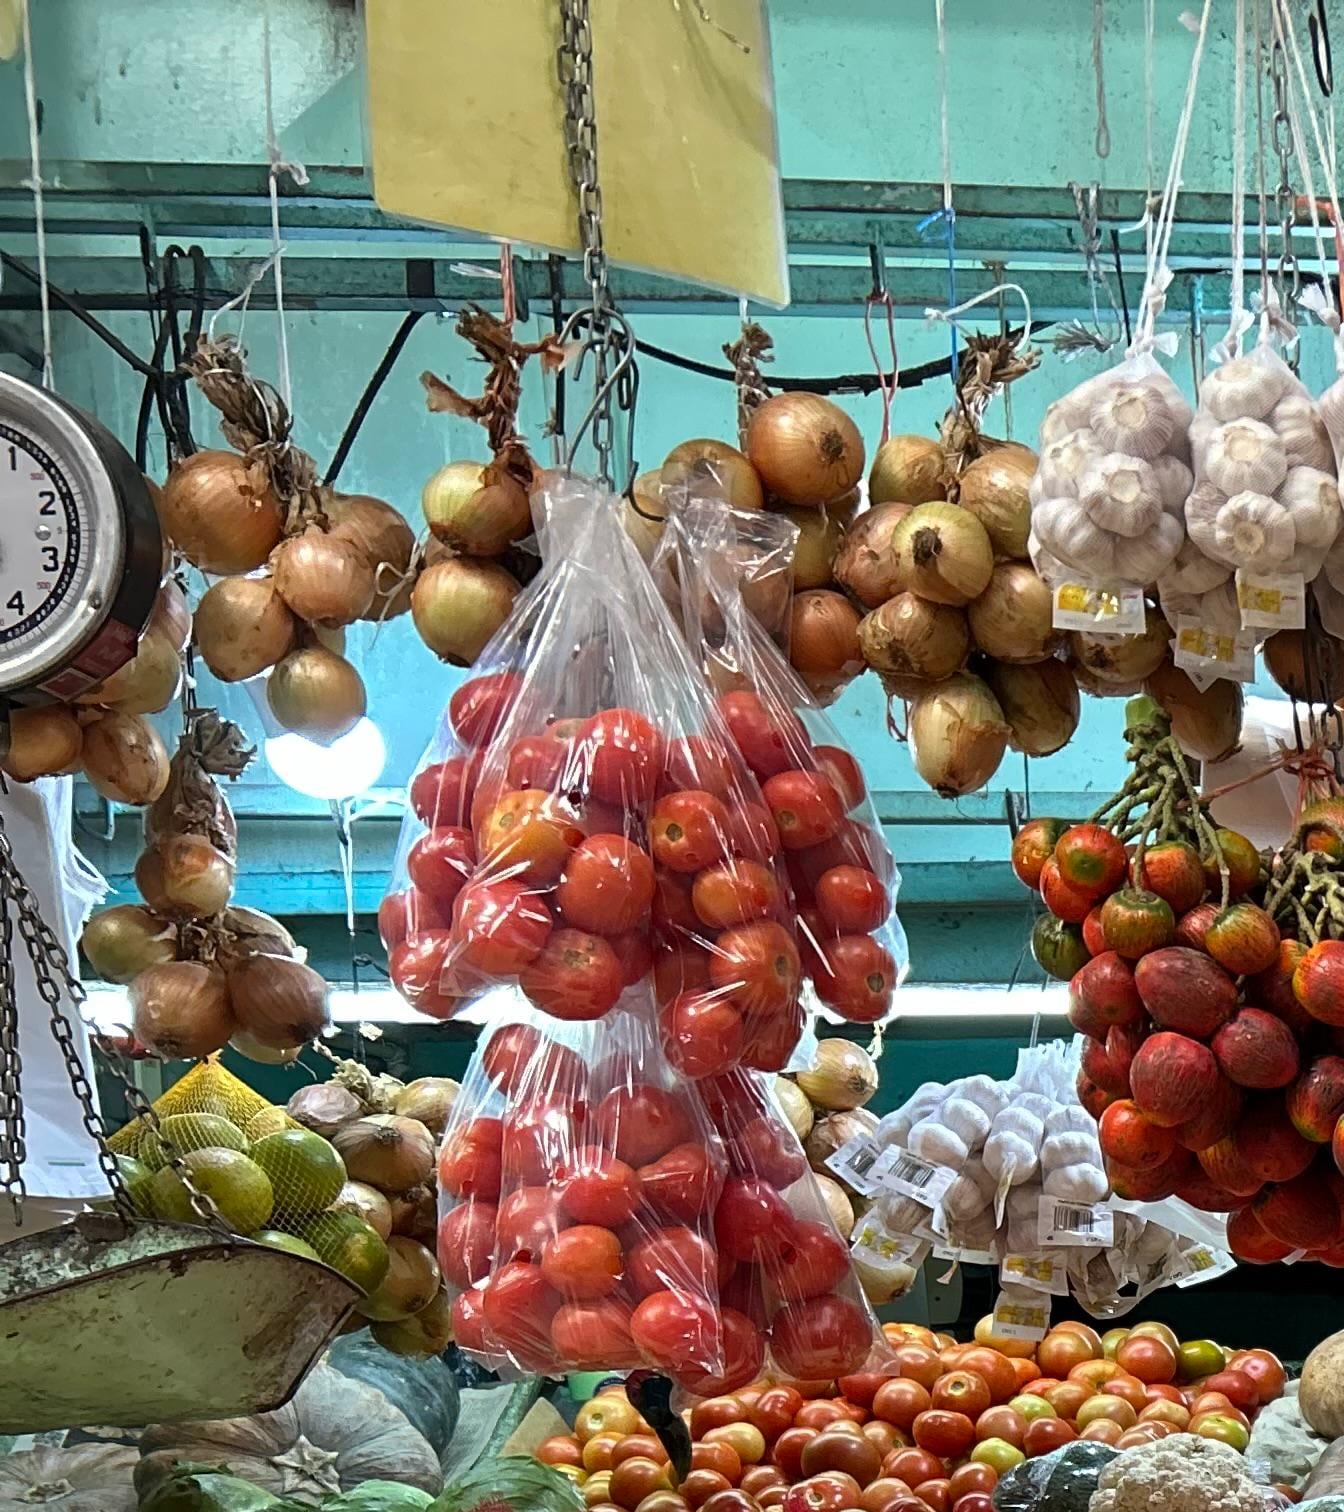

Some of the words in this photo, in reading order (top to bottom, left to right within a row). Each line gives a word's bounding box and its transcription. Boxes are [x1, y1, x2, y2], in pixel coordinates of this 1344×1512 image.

[8, 446, 17, 471] 1
[39, 491, 57, 516] 2
[41, 547, 59, 573] 3
[6, 591, 25, 616] 4
